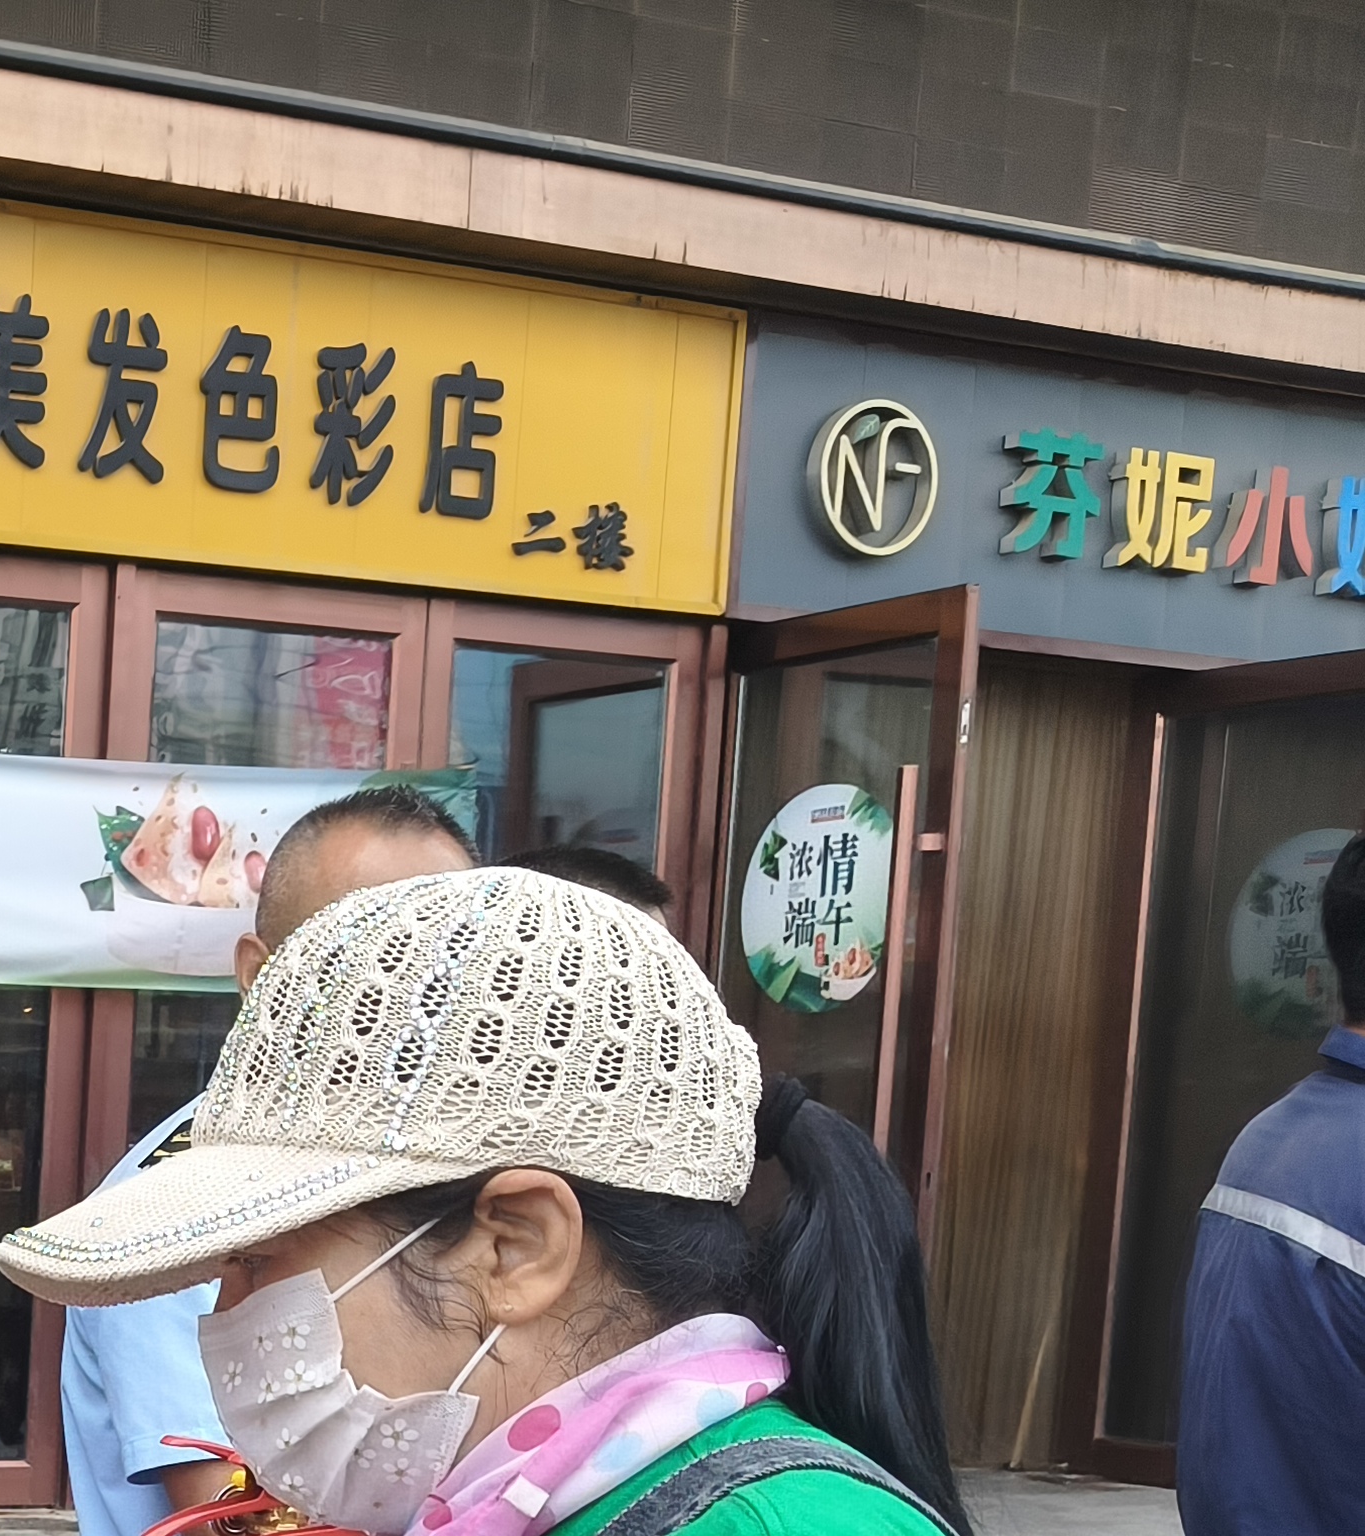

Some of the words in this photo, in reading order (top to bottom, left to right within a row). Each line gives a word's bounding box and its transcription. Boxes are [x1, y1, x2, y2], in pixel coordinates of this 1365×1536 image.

[511, 502, 635, 572] 二楼
[788, 832, 860, 898] 浓情
[782, 897, 854, 949] 端午
